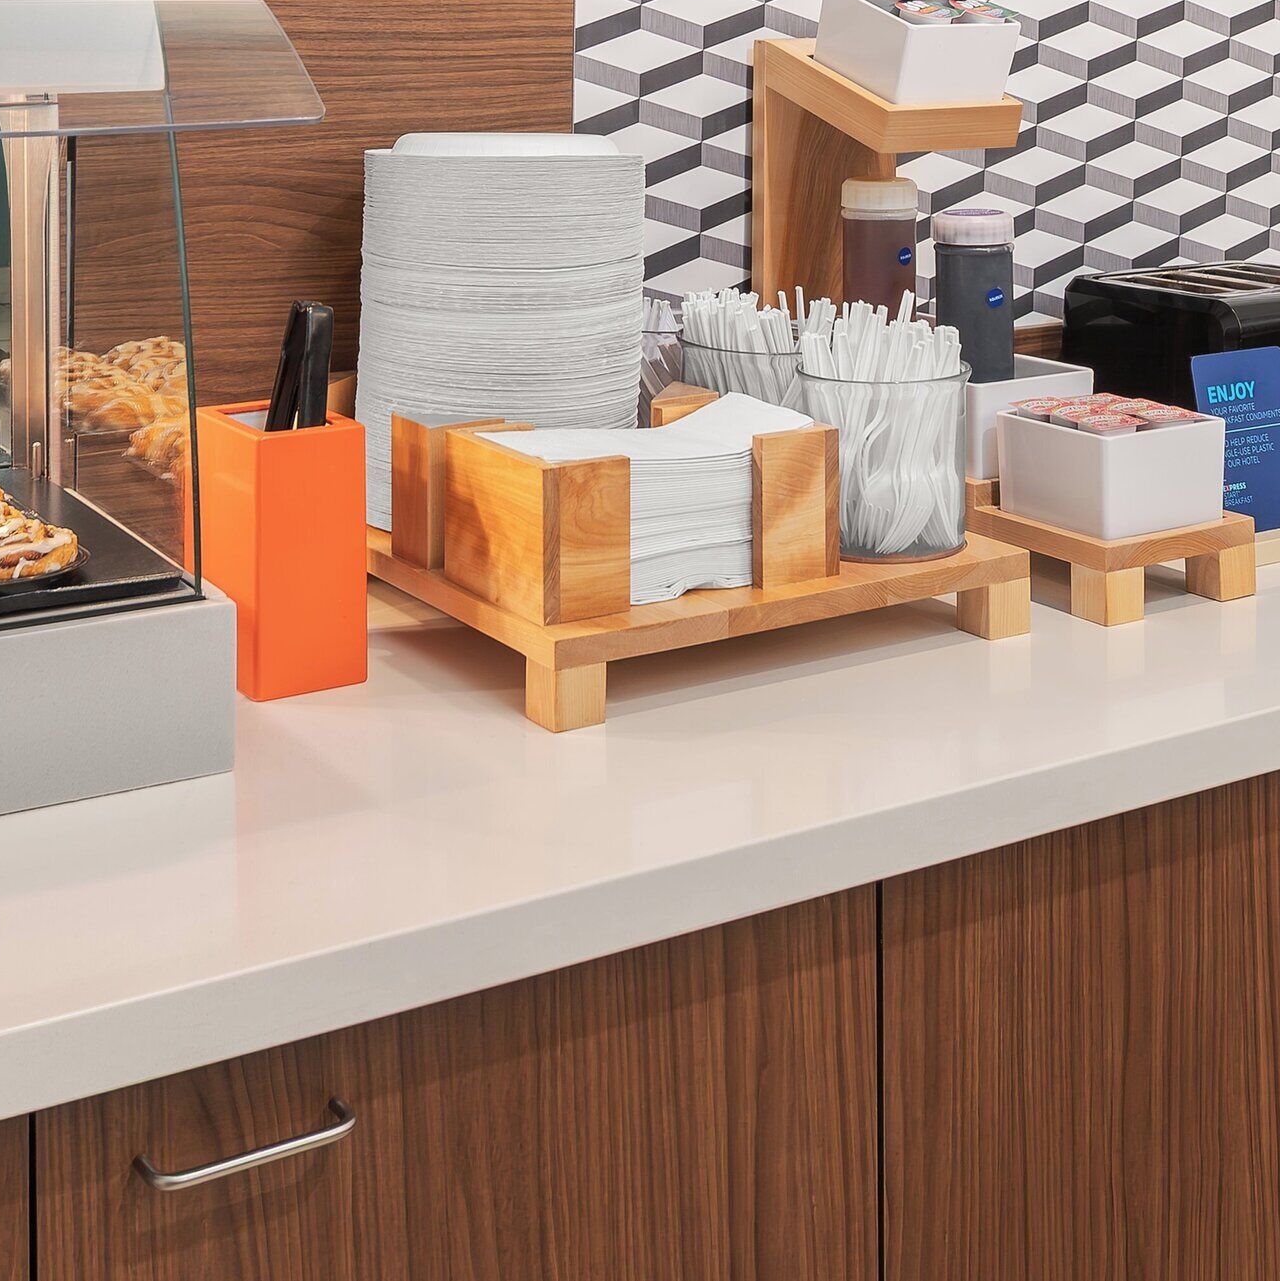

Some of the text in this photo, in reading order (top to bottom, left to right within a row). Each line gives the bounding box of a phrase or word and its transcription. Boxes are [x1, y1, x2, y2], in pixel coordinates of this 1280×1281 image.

[1207, 380, 1255, 404] ENJOY
[1210, 402, 1256, 416] YOUR FAVORITE
[1224, 413, 1245, 424] KFAST
[1230, 436, 1246, 447] HELP
[1246, 433, 1269, 444] REDUCE
[1225, 442, 1275, 458] GLE-USE PLASTIC
[1227, 458, 1241, 468] OUR
[1241, 455, 1261, 466] HOTEL
[1224, 496, 1253, 507] BREAKFAST
